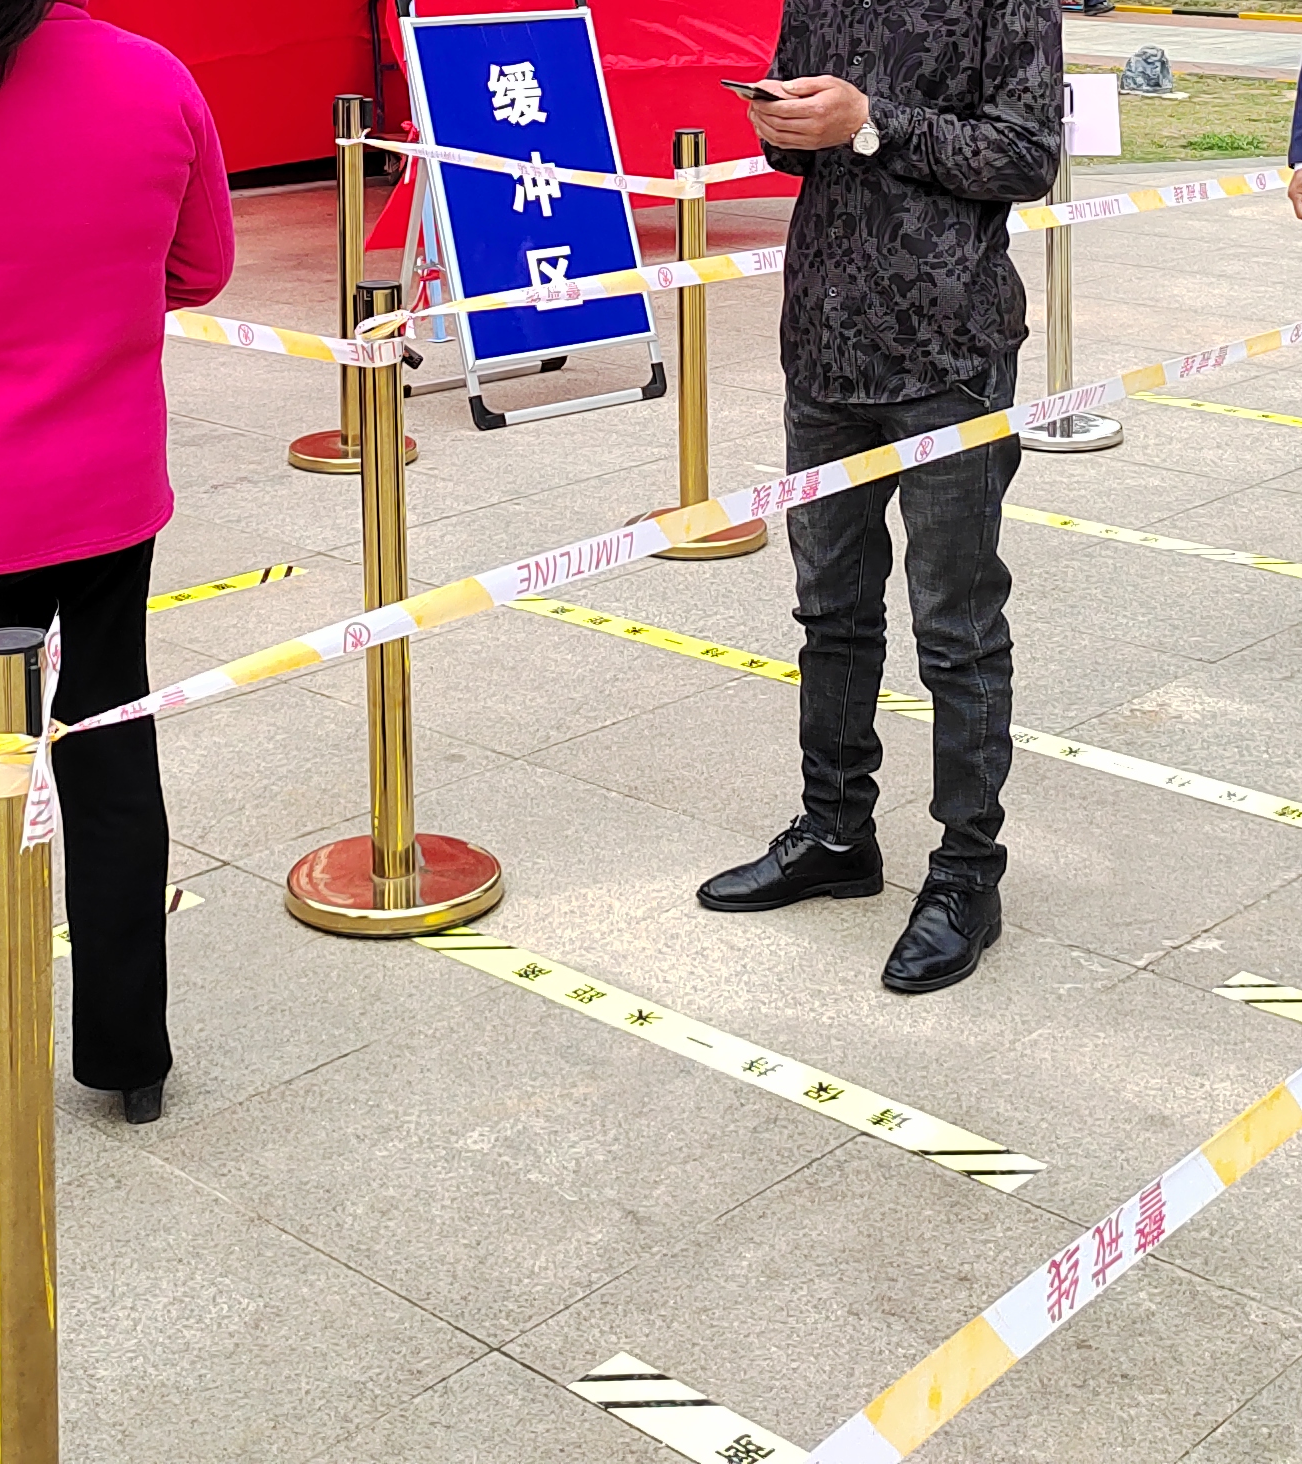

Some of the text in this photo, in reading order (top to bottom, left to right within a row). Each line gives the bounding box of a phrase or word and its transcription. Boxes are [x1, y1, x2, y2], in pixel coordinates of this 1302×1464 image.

[487, 61, 585, 310] 缓冲区
[1025, 384, 1106, 427] LIMITLINE
[517, 532, 634, 595] LIMITLINE
[513, 961, 912, 1133] 请保持一米距离
[1047, 1176, 1167, 1324] 警戒线
